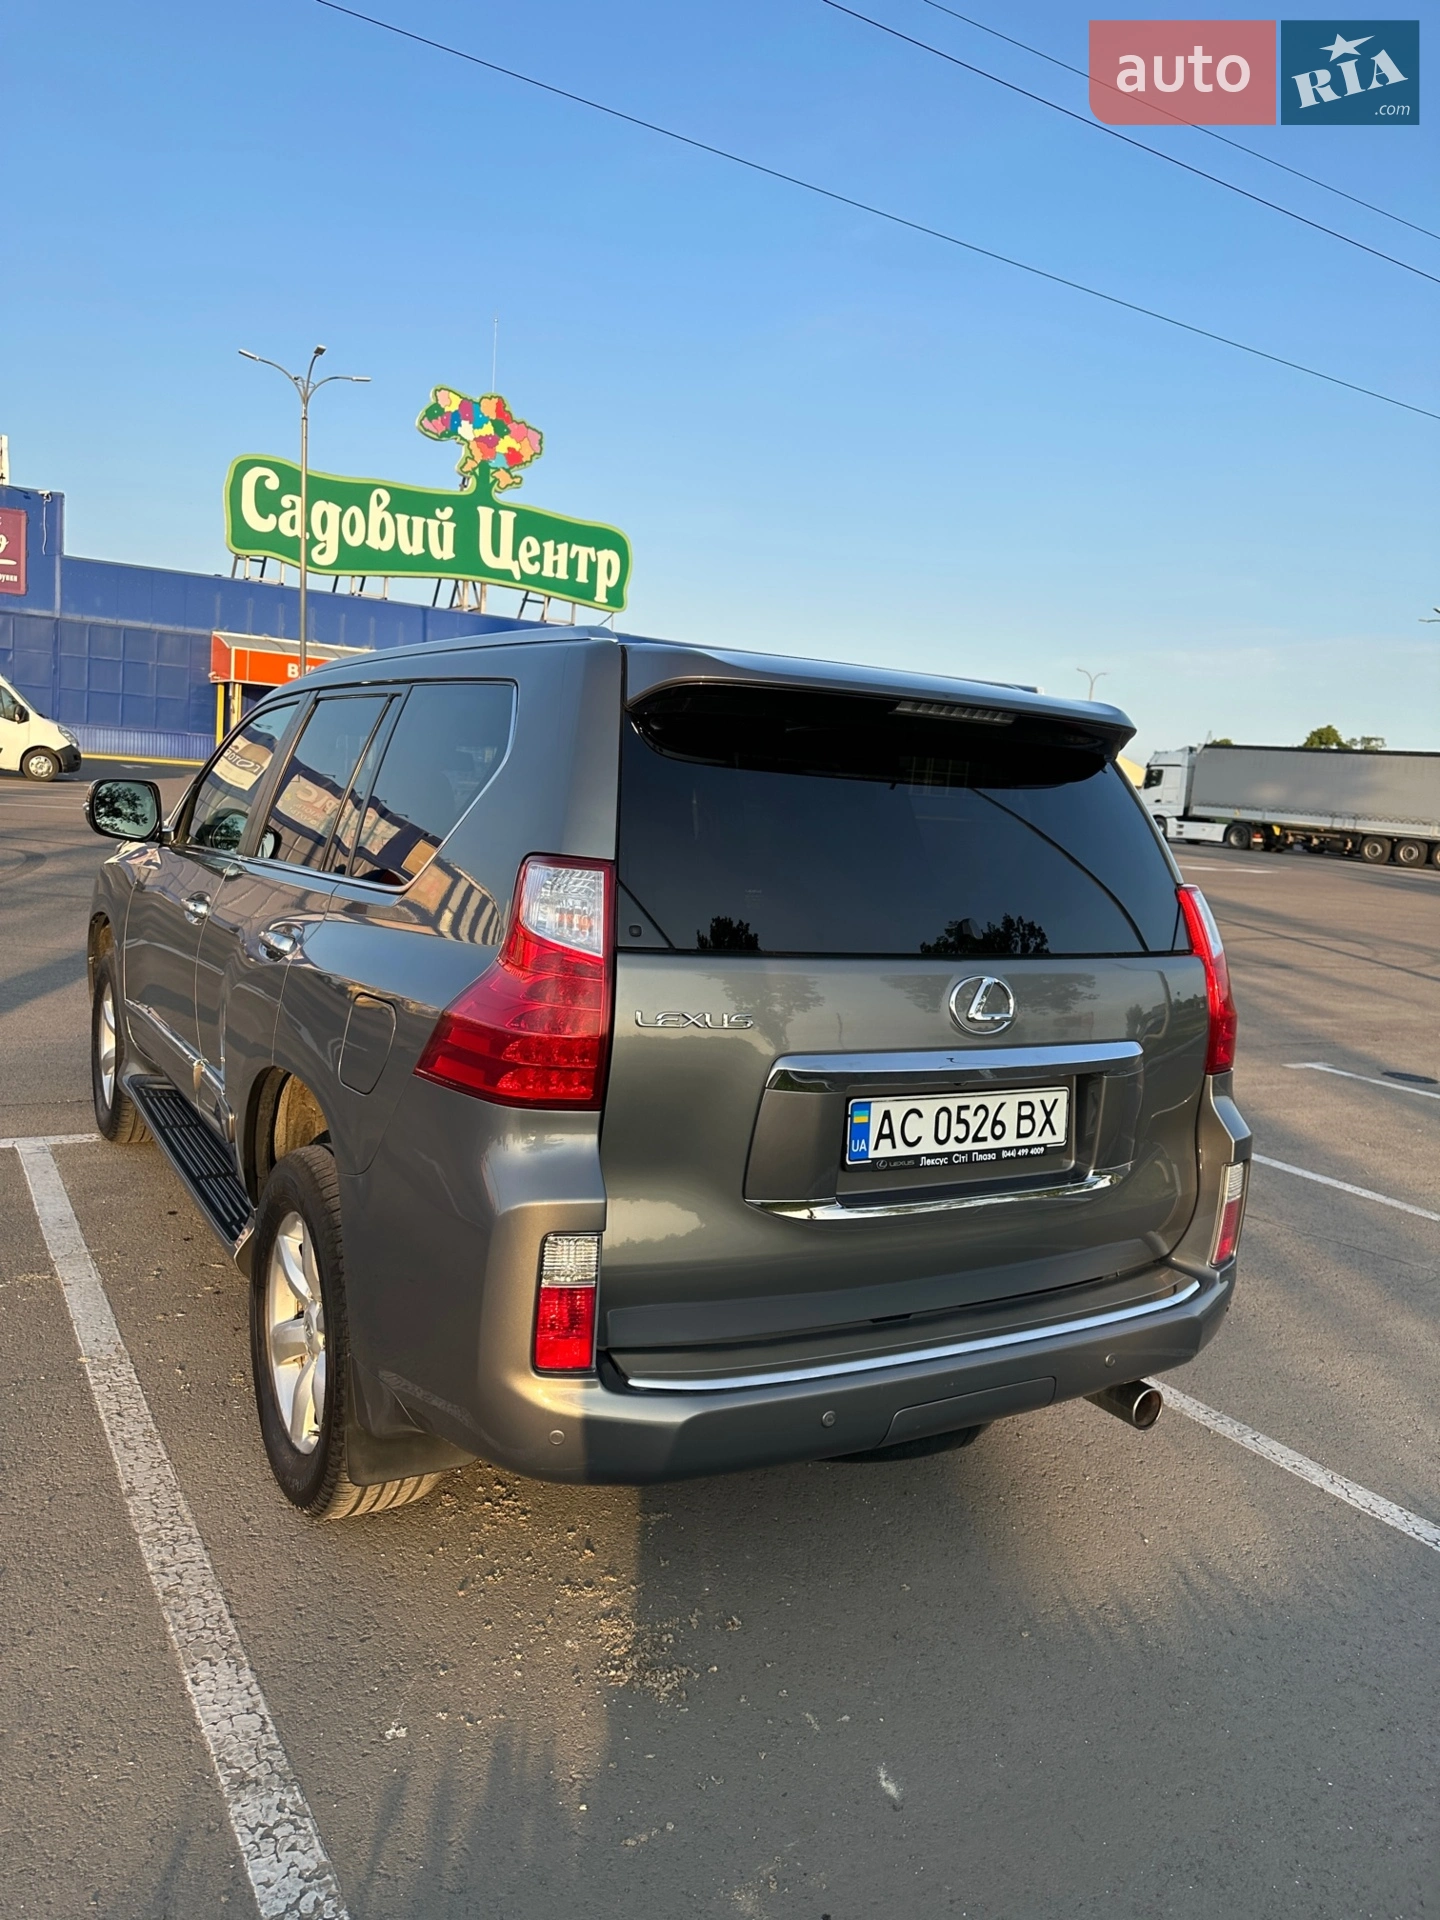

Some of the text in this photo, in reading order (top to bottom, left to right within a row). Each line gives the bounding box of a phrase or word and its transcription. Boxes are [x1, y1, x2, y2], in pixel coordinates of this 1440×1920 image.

[241, 466, 621, 603] Садовий Центр
[634, 1010, 754, 1030] LEXUS
[873, 1097, 1059, 1151] AC 0526 BX
[851, 1139, 867, 1153] UA
[889, 1159, 915, 1168] LEXUS
[919, 1146, 1045, 1167] Лексус Сіті Плаза (044) 499 4009
